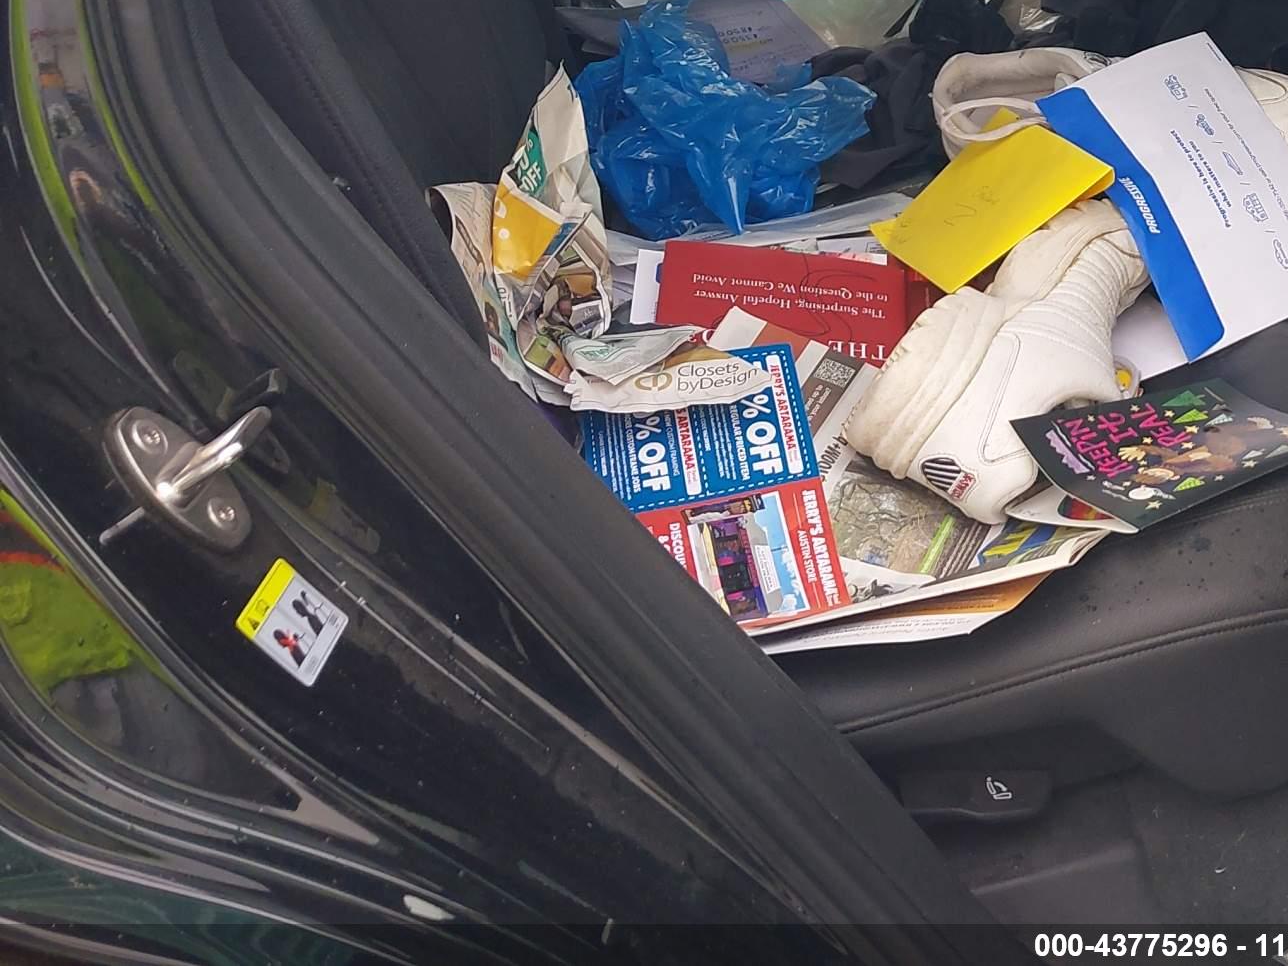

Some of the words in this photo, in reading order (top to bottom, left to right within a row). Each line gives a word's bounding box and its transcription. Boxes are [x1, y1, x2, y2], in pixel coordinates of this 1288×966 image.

[1169, 128, 1191, 155] protect
[1201, 160, 1223, 190] matters
[1120, 176, 1161, 235] PROGRESSIVE
[1204, 183, 1234, 229] Progressive
[1217, 189, 1233, 209] what
[692, 272, 727, 286] Avoid
[730, 276, 774, 291] Cannot
[776, 282, 796, 294] We
[693, 289, 738, 303] Answer
[743, 293, 791, 309] Hopeful
[799, 283, 853, 300] Question
[854, 290, 873, 301] the
[875, 292, 888, 302] to
[794, 297, 859, 315] Surprising,
[861, 306, 885, 318] The
[827, 338, 887, 362] THE
[676, 362, 739, 379] Closets
[676, 368, 758, 394] byDesign
[769, 364, 787, 397] JERRY'S
[729, 405, 743, 436] REGULAR
[777, 398, 797, 450] ARTARAMA
[1131, 401, 1190, 450] REAL
[625, 429, 636, 454] CUSTOM
[667, 428, 676, 449] CUSTOM
[678, 416, 695, 470] ARTARAMA
[734, 436, 747, 462] PRICED
[745, 420, 783, 476] OFF
[629, 454, 638, 475] FRAME
[637, 441, 671, 492] OFF
[670, 450, 680, 476] FRAMING
[739, 461, 751, 481] ITEM
[632, 475, 641, 492] JOBS
[801, 489, 824, 535] JERRY'S
[797, 529, 811, 560] AUSTIN
[803, 559, 816, 583] STORE
[812, 536, 837, 598] ARTARAMA
